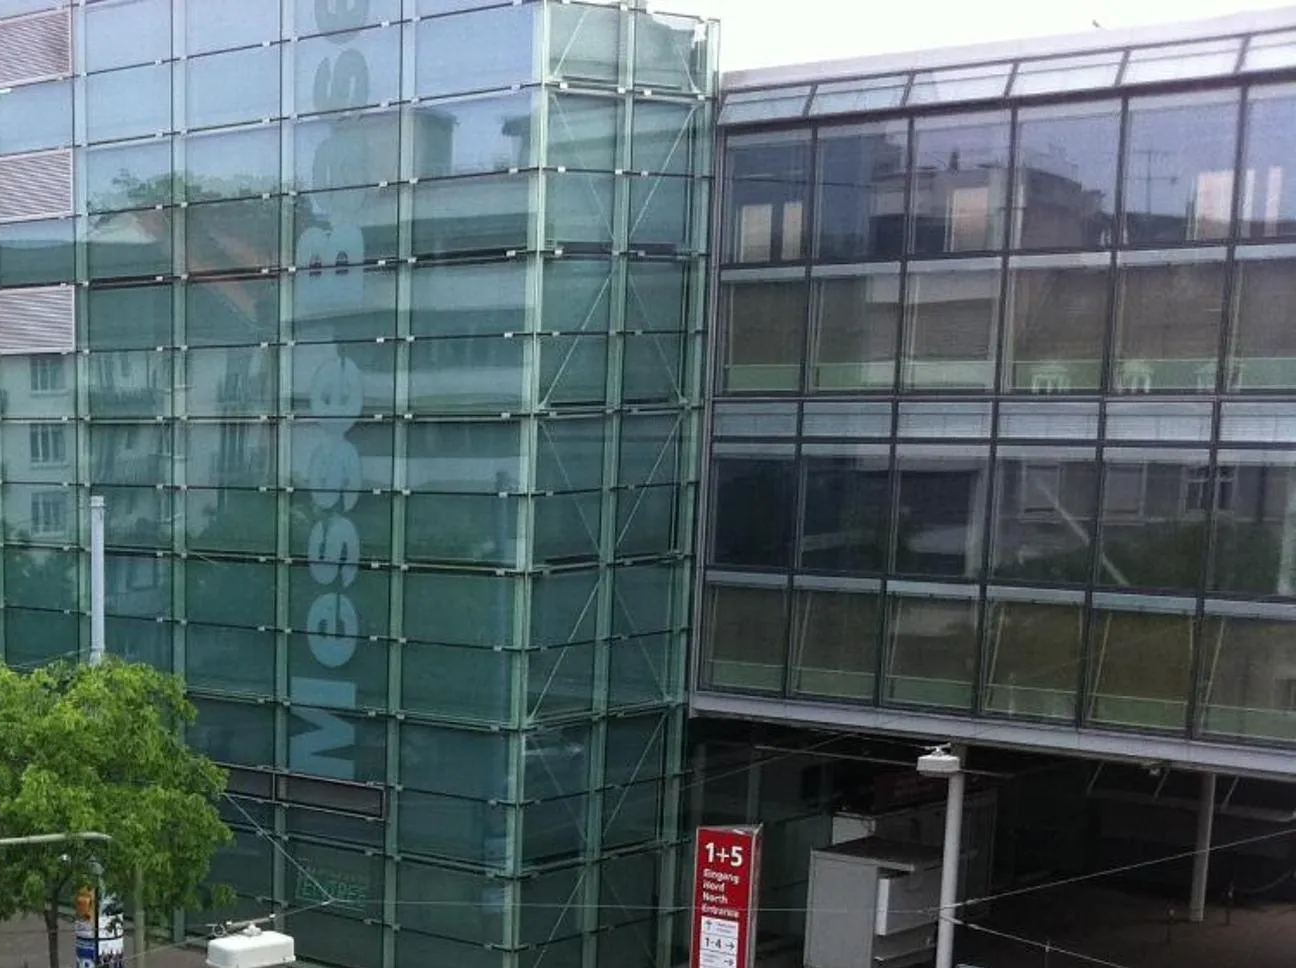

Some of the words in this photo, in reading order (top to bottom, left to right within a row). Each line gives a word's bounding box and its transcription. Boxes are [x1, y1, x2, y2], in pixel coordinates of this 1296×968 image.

[289, 354, 362, 778] Messe
[705, 842, 743, 867] 1+5
[703, 868, 740, 886] Eingang
[703, 881, 725, 892] Nord
[703, 891, 728, 904] North
